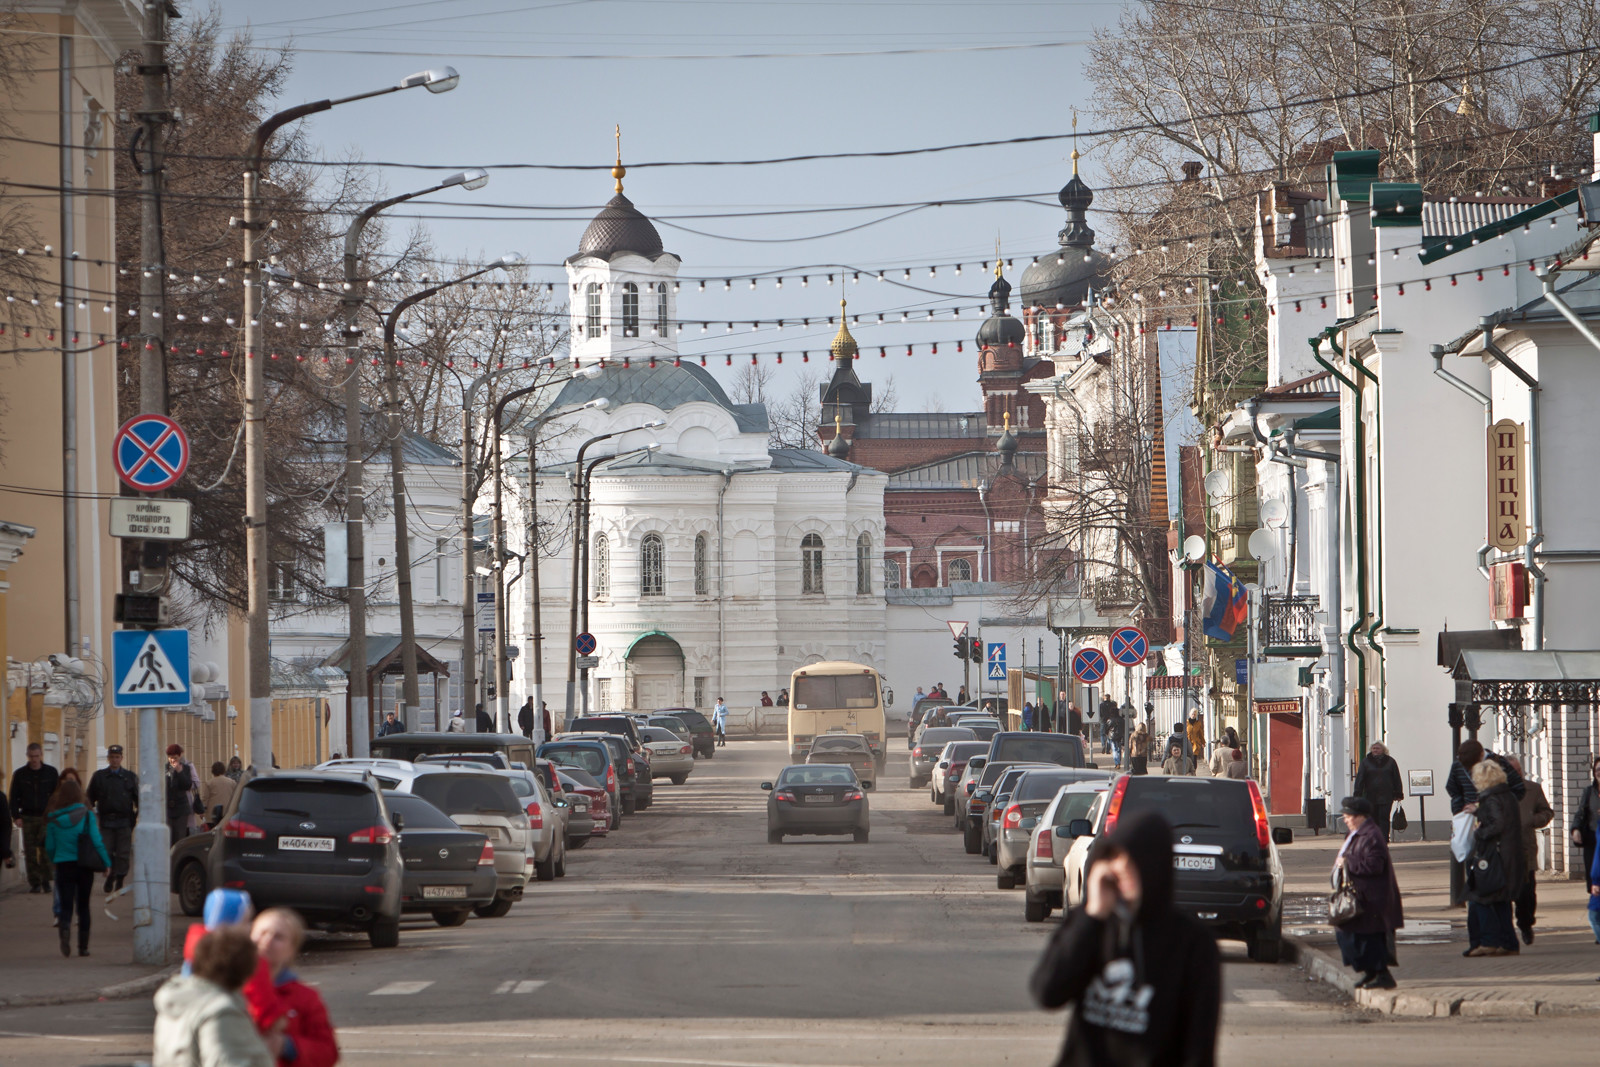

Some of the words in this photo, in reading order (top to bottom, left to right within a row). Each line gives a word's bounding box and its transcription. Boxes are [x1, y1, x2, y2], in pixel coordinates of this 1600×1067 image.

[1497, 432, 1519, 539] ПИЦЦА
[136, 504, 161, 513] КРОМЕ
[127, 514, 171, 524] ТРАНСПОРТА
[129, 524, 149, 533] ФСБ
[151, 525, 170, 535] УВД
[1174, 857, 1200, 868] 11СО
